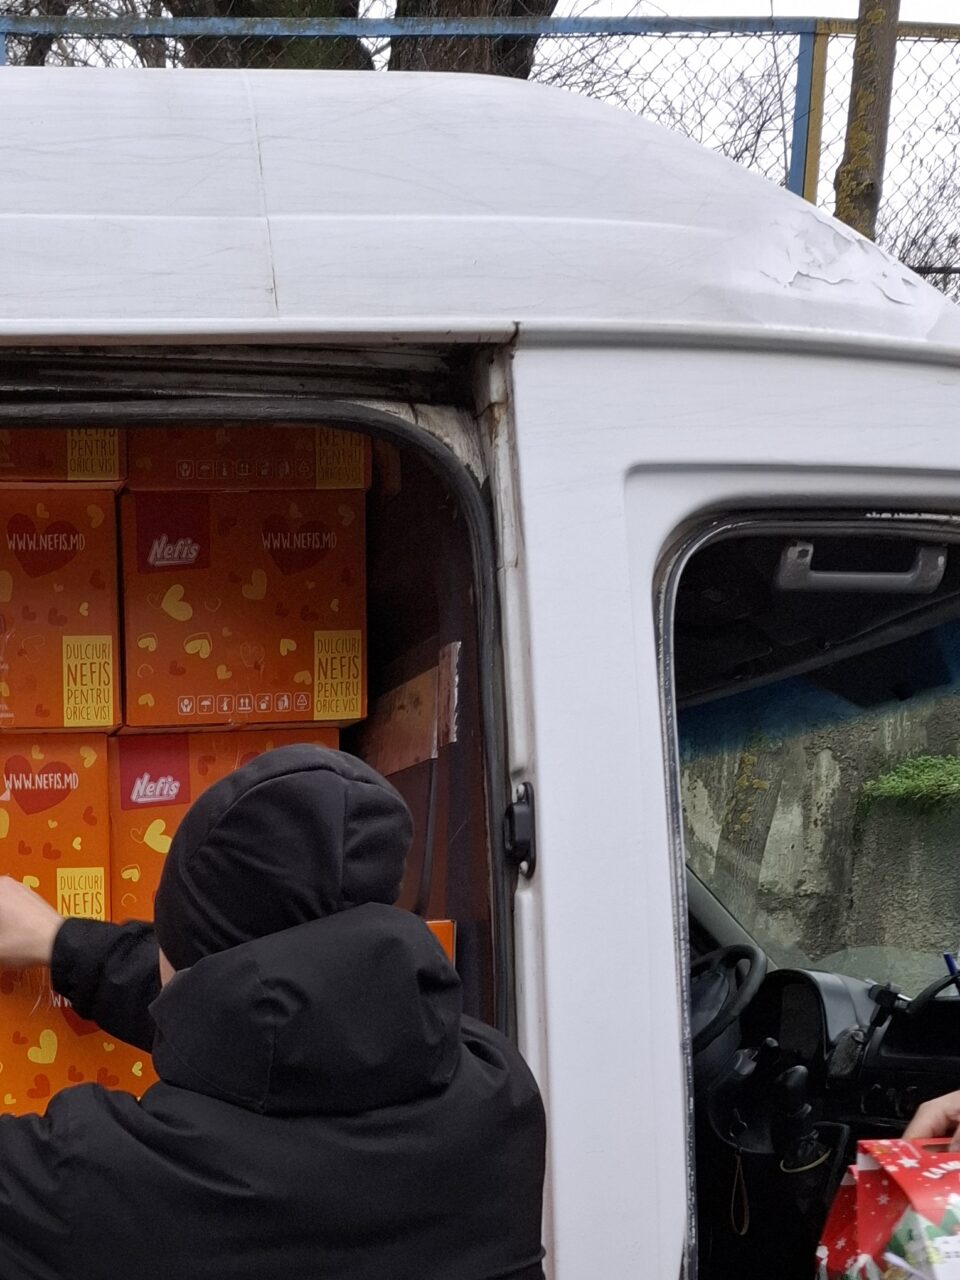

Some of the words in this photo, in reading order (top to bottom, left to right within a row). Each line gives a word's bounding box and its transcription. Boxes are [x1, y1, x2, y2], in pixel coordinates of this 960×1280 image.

[71, 440, 116, 457] PENTRU
[6, 532, 86, 551] WWW.NEFIS.MD
[147, 533, 201, 567] Nefis
[261, 531, 338, 550] WWW.NEFIS.MD
[65, 643, 111, 661] DULCIURI
[316, 637, 361, 655] DULCIURI
[66, 661, 111, 687] NEFIS
[317, 655, 360, 681] NEFIS
[67, 687, 110, 706] PENTRU
[317, 680, 360, 699] PENTRU
[65, 704, 92, 721] ORICE
[316, 698, 341, 714] ORICE
[3, 772, 80, 791] WWW.NEFIS.MD
[130, 772, 181, 803] Nefis
[60, 875, 103, 891] DULCIURI
[61, 891, 103, 915] NEFIS
